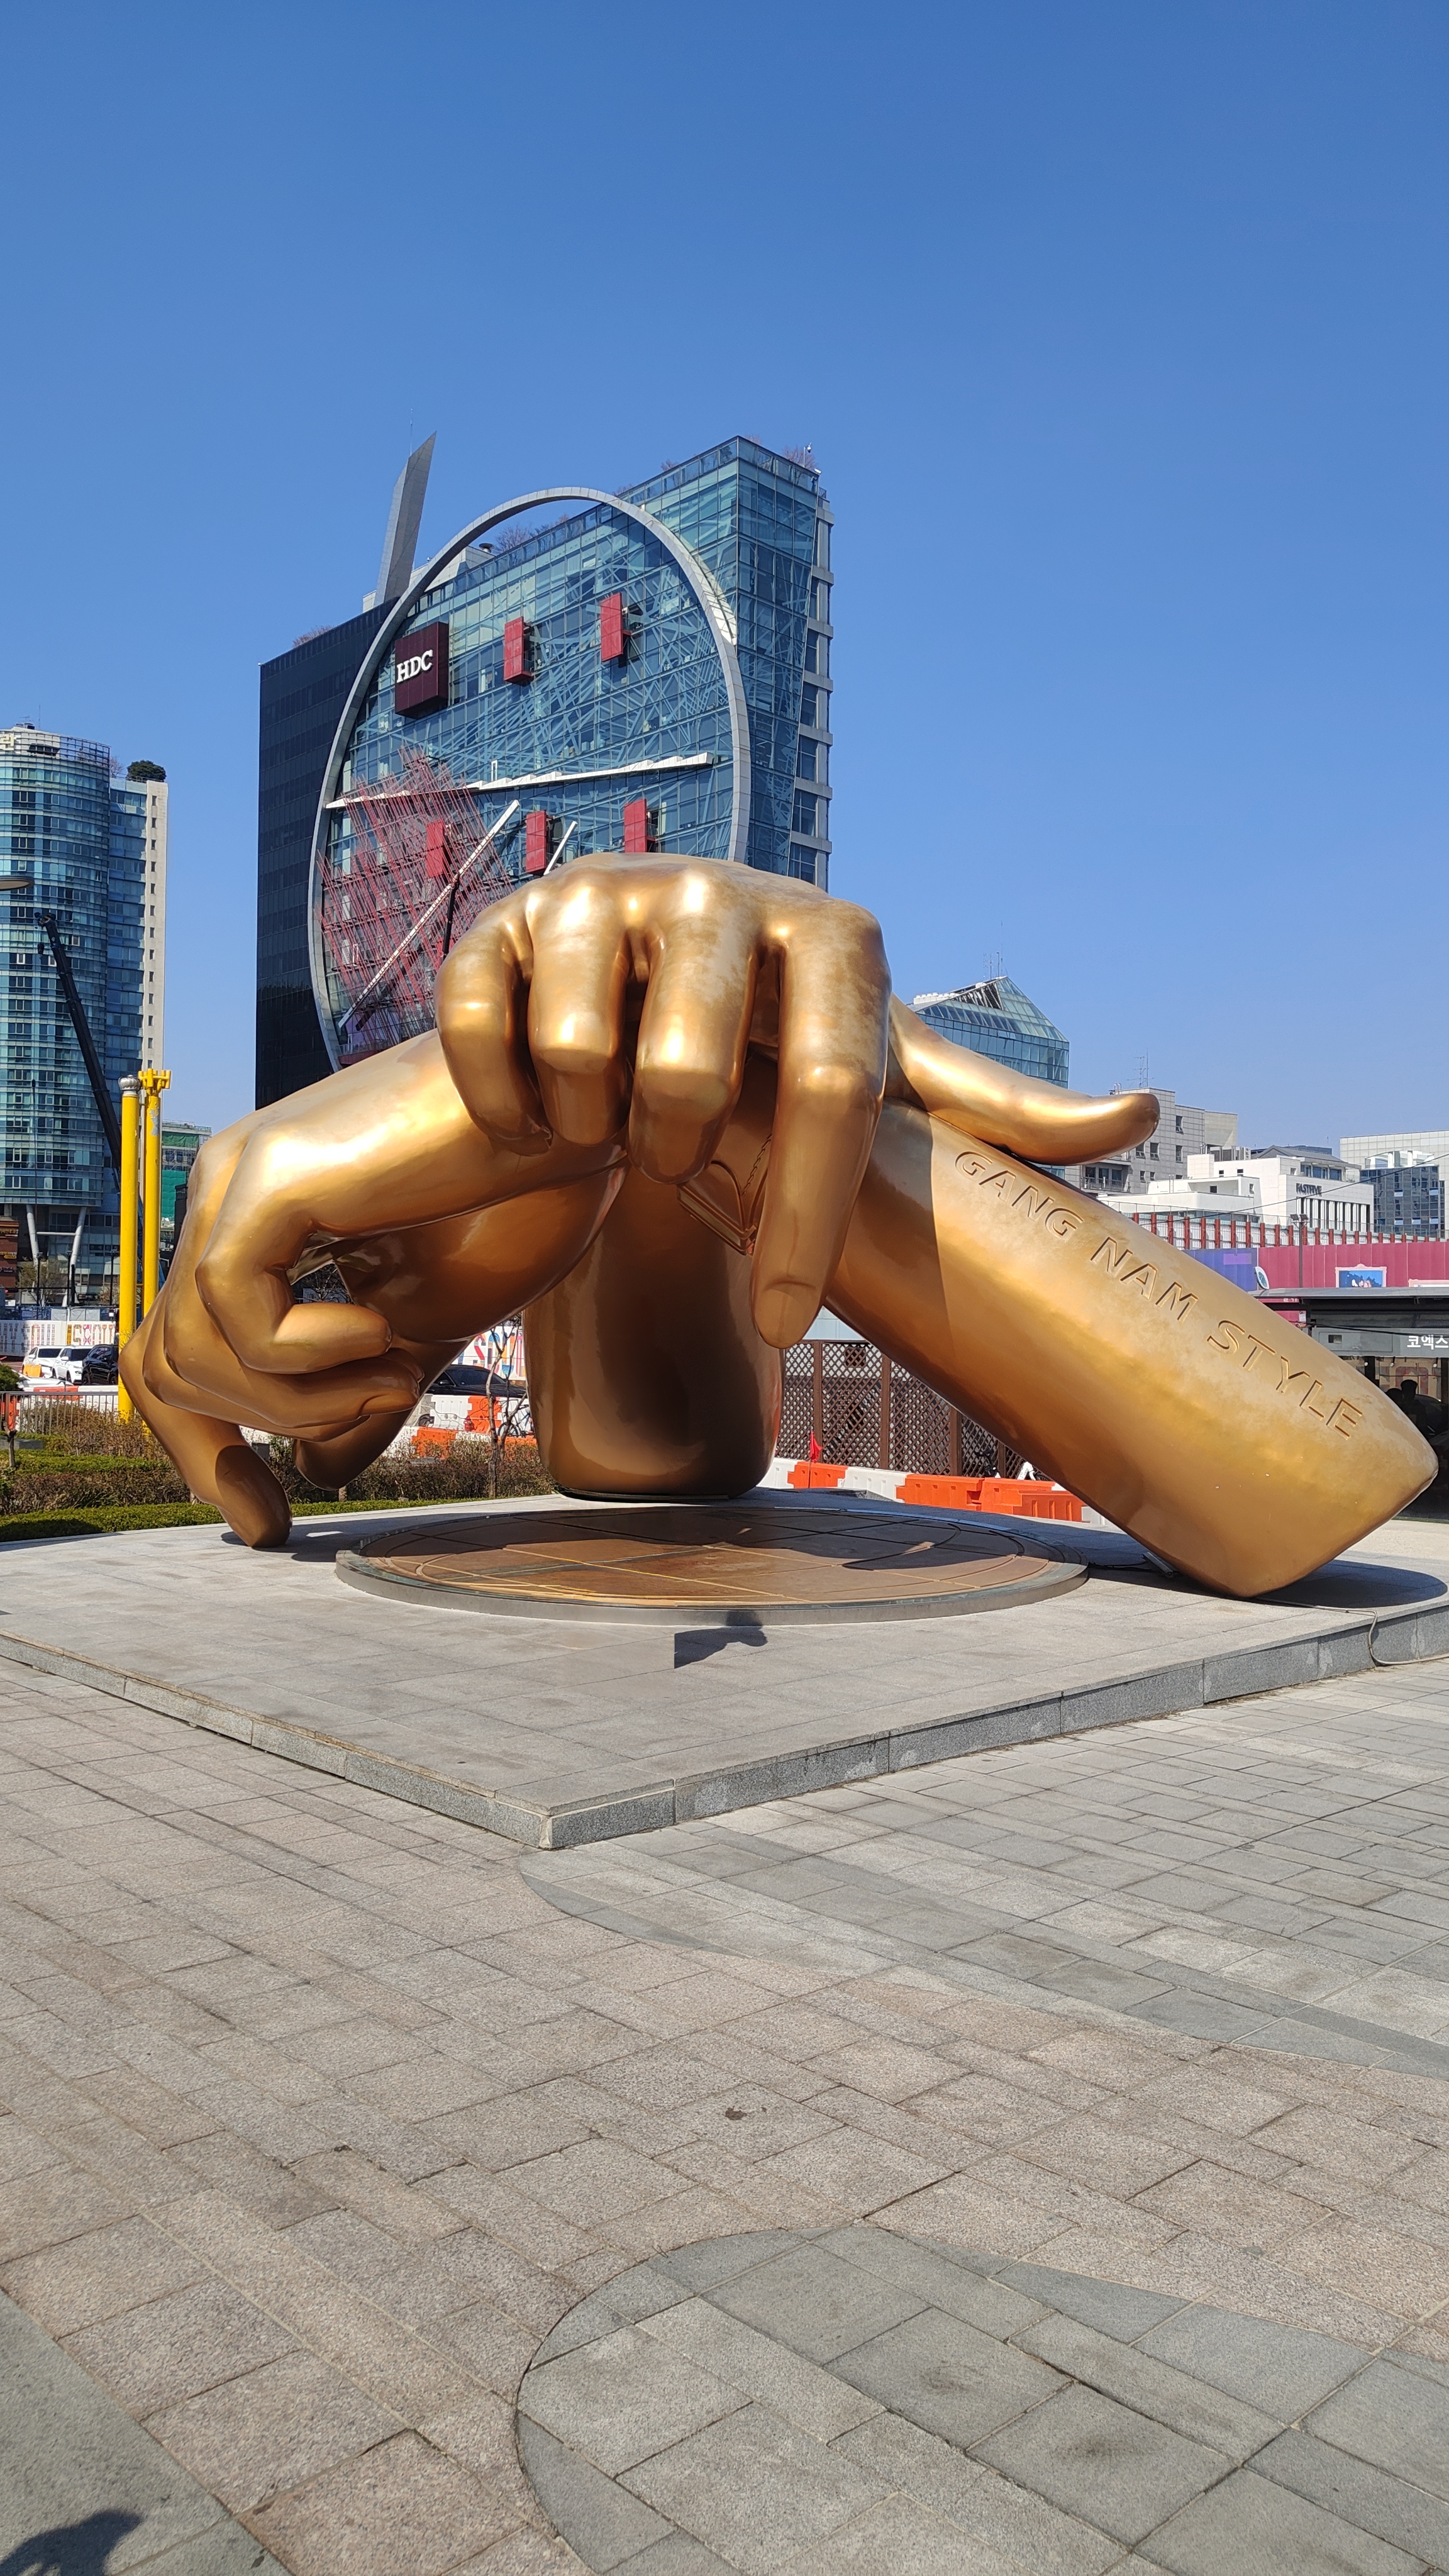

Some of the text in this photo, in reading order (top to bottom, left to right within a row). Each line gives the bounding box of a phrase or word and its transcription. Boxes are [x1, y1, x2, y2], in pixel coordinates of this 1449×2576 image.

[396, 649, 433, 683] HDC
[955, 1151, 1363, 1441] GANG NAM STYLE
[1407, 1334, 1449, 1350] 코엑스
